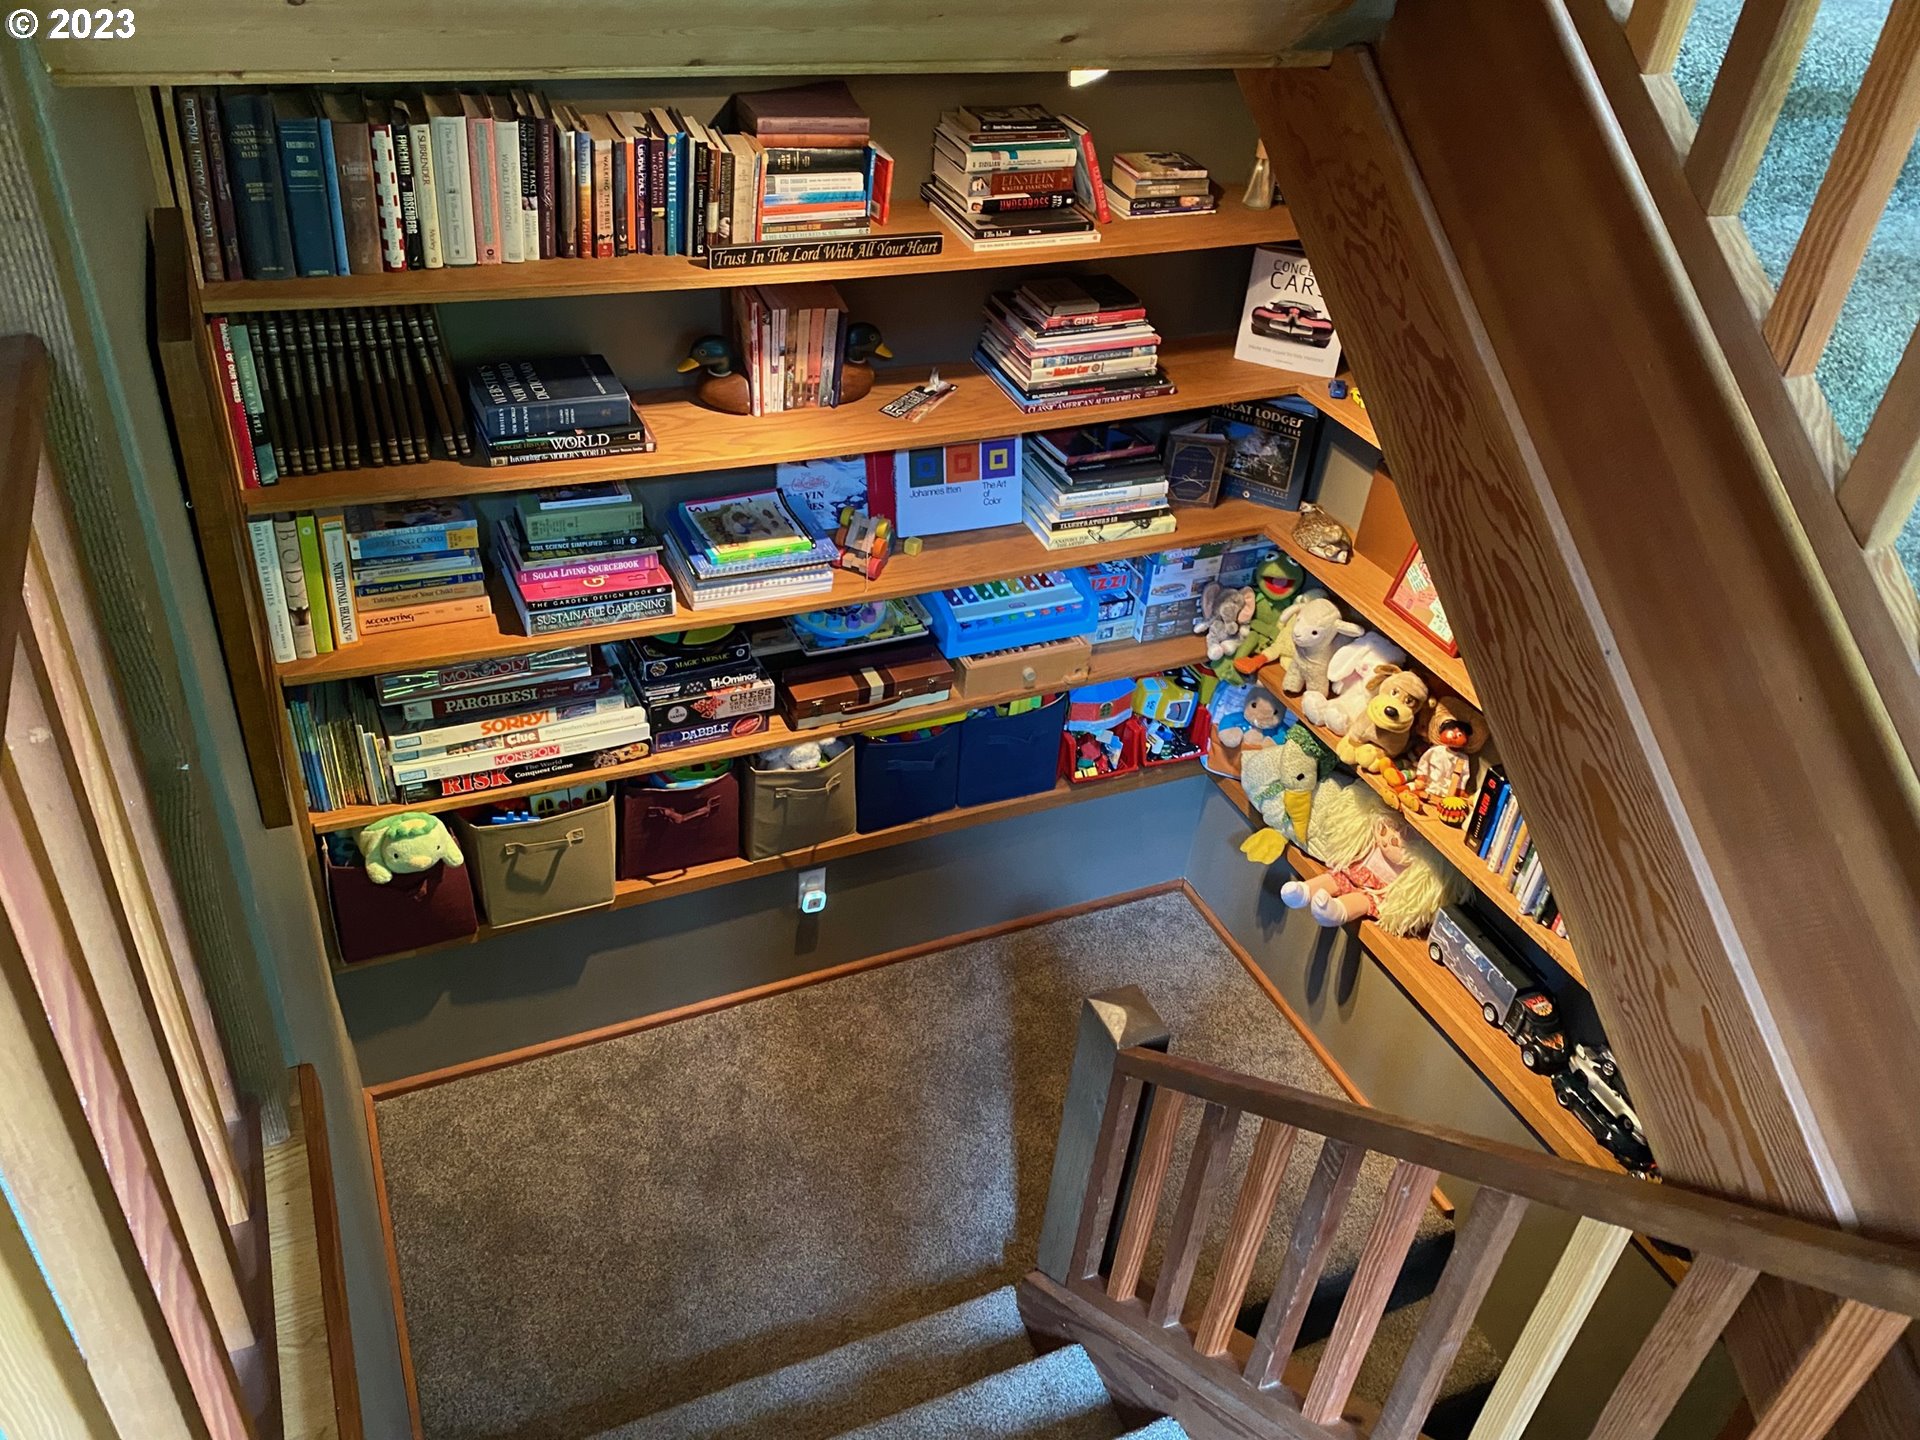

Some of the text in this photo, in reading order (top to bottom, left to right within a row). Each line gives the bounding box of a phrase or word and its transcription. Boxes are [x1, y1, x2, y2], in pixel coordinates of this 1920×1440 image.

[185, 98, 200, 145] PICTORIAL
[417, 134, 431, 186] SURRENDER
[579, 139, 591, 185] Abraham
[521, 147, 530, 195] APARTHEID
[1001, 172, 1057, 187] EINSTEIN
[397, 134, 418, 235] EPICENTER ROSENBERG
[714, 237, 939, 267] Trust In The Lord With All Your Heart
[1269, 271, 1323, 298] CAR
[1073, 315, 1099, 327] GUTS
[218, 321, 232, 352] IMAGES
[225, 352, 234, 363] OF
[227, 364, 238, 380] OUR
[1052, 364, 1091, 377] Motor Car
[477, 364, 508, 405] WEBSTER'S
[499, 362, 529, 403] NEW WORLD
[519, 362, 551, 401] DICTIONARY
[1027, 392, 1142, 414] CLASSIC AMERICAN AUTOMOBILES
[1031, 390, 1069, 400] SUPERCARS
[1254, 407, 1305, 428] LODGES
[550, 433, 610, 451] WORLD
[582, 448, 607, 458] WORLD
[909, 488, 945, 499] Johannes
[981, 479, 1007, 490] The Art
[983, 489, 990, 498] of
[1066, 488, 1128, 501] Architectural Drawing
[983, 496, 1002, 506] Color
[1060, 517, 1110, 529] ILLUSTRATORS
[416, 535, 444, 545] GOOD
[530, 539, 604, 552] SOIL SCIENCE SIMPLIFIED
[253, 522, 276, 607] HEALING REMEDIES
[277, 528, 308, 599] BODY
[532, 559, 640, 581] SOLAR LIVING SOURCEBOOK
[332, 561, 348, 606] NUTRITIONAL
[532, 588, 653, 609] THE GARDEN DESIGN BOOK
[339, 605, 353, 634] HEALING
[365, 612, 416, 626] ACCOUNTING
[536, 604, 606, 627] SUSTAINABLE
[605, 597, 667, 615] GARDENING
[441, 658, 528, 684] MONOPOLY
[674, 652, 730, 670] MAGIC MOSAIC
[444, 687, 539, 714] PARCHEESI
[729, 687, 772, 703] CHESS
[480, 710, 550, 736] SORRY!
[680, 721, 731, 742] DABBLE
[506, 731, 538, 746] Clue
[494, 745, 560, 766] MONOPOLY
[524, 758, 563, 771] The World
[514, 761, 574, 779] Conquest Game
[440, 767, 513, 797] RISK
